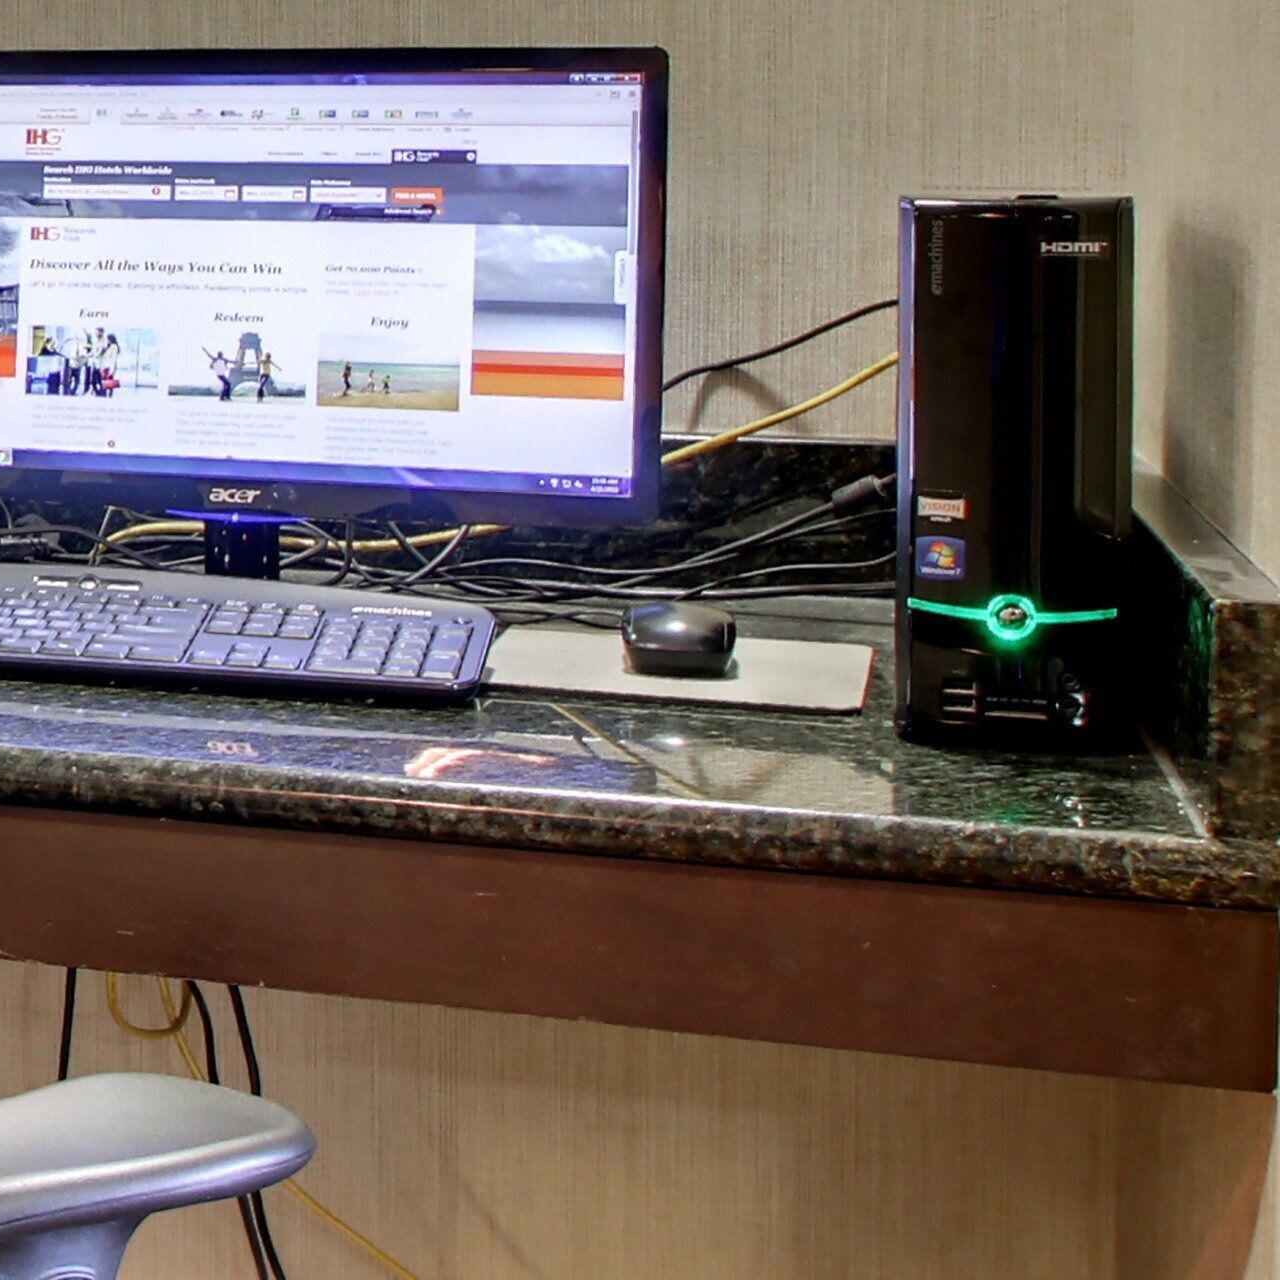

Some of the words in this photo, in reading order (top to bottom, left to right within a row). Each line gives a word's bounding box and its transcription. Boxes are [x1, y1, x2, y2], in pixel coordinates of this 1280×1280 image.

[26, 128, 62, 146] IHG
[30, 226, 61, 241] IHG
[928, 219, 944, 296] emachines
[29, 258, 91, 270] Discover
[93, 259, 114, 271] All
[117, 259, 140, 271] the
[144, 260, 184, 275] Ways
[188, 261, 216, 274] You
[218, 262, 248, 275] Can
[253, 263, 283, 275] Win
[78, 308, 110, 320] Earn
[213, 312, 264, 324] Redeem
[370, 316, 410, 330] Enjoy
[208, 487, 262, 504] acer
[922, 501, 961, 513] VISION
[351, 606, 433, 618] emachines
